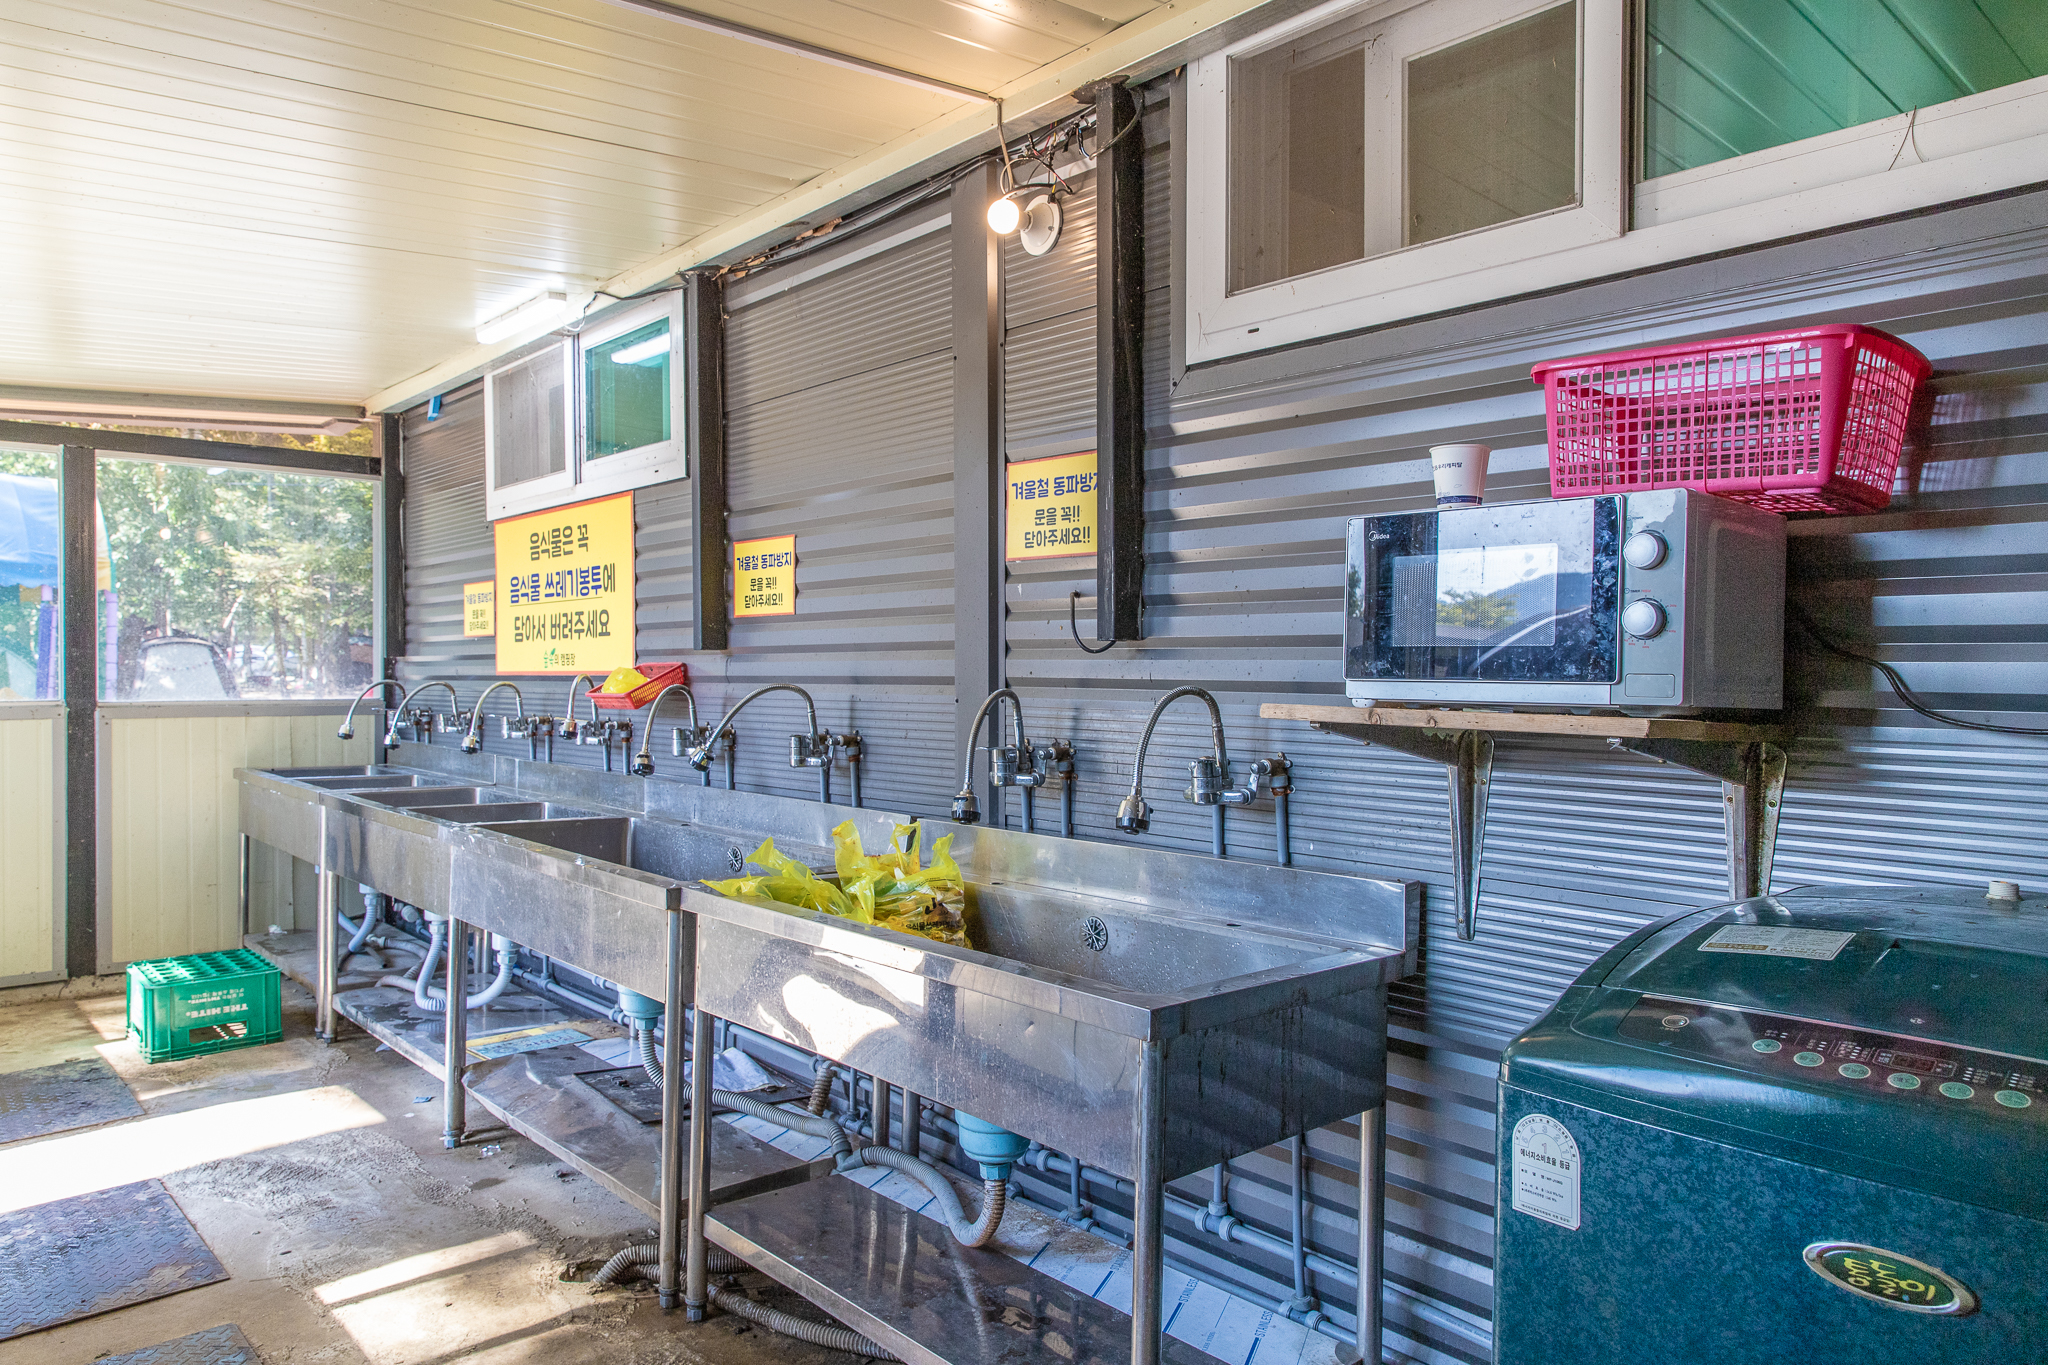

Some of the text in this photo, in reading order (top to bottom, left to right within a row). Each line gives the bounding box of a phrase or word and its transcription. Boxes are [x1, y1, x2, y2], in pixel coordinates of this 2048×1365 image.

[1012, 478, 1049, 500] 겨울철
[1034, 505, 1080, 526] 문을 꼭!!
[530, 524, 589, 561] 음식물은 꼭
[1024, 526, 1090, 549] 닫아주세요!!
[736, 551, 792, 571] 겨울철 동파방지
[510, 562, 615, 604] 음식물 쓰레기봉투에
[750, 576, 777, 592] 문을 꼭!!
[745, 593, 783, 609] 닫아주세요!!
[514, 609, 611, 643] 담아서 버려주세요
[223, 1003, 248, 1013] THE
[1843, 1257, 1936, 1300] 통돌이
[1178, 1278, 1200, 1303] STAINLESS
[1254, 1310, 1274, 1338] STAINLESS
